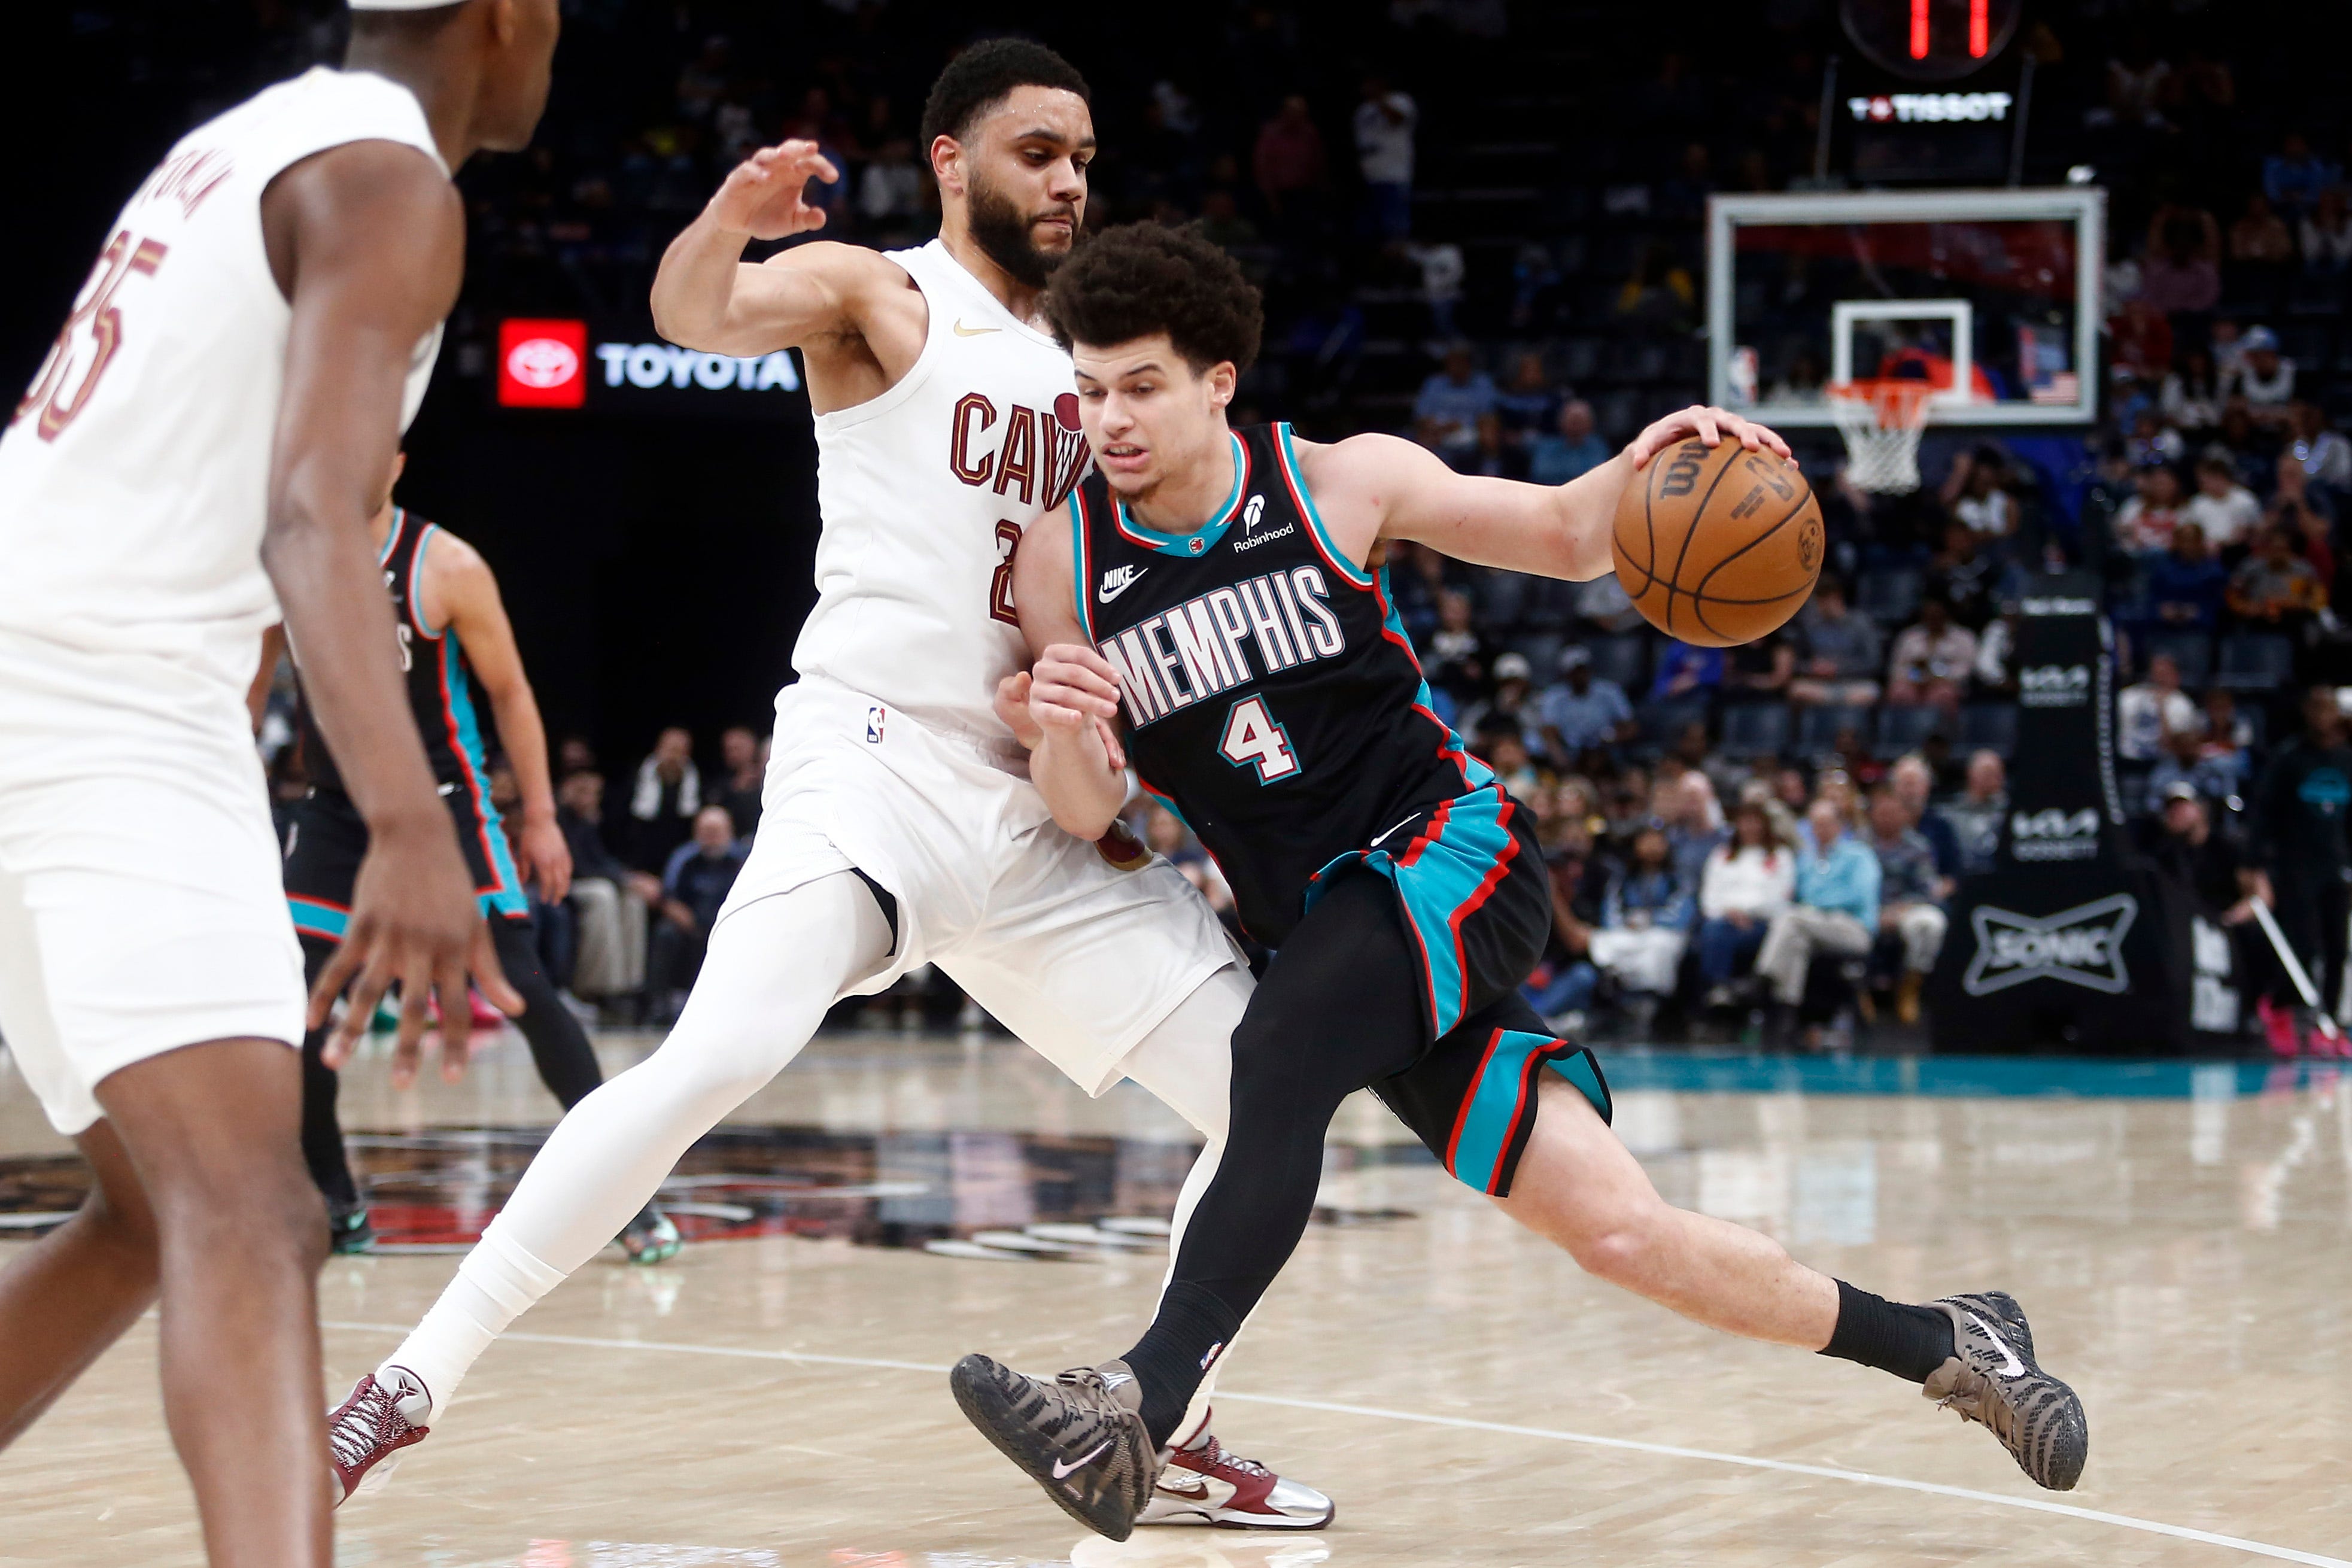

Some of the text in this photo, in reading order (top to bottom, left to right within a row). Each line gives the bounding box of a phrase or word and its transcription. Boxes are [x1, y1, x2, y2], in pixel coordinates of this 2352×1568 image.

[1233, 522, 1294, 553] Robinhood
[1104, 564, 1134, 591] NIKE
[1098, 566, 1345, 731] MEMPHIS
[1217, 694, 1302, 786] 4
[1990, 927, 2110, 968] SONIC
